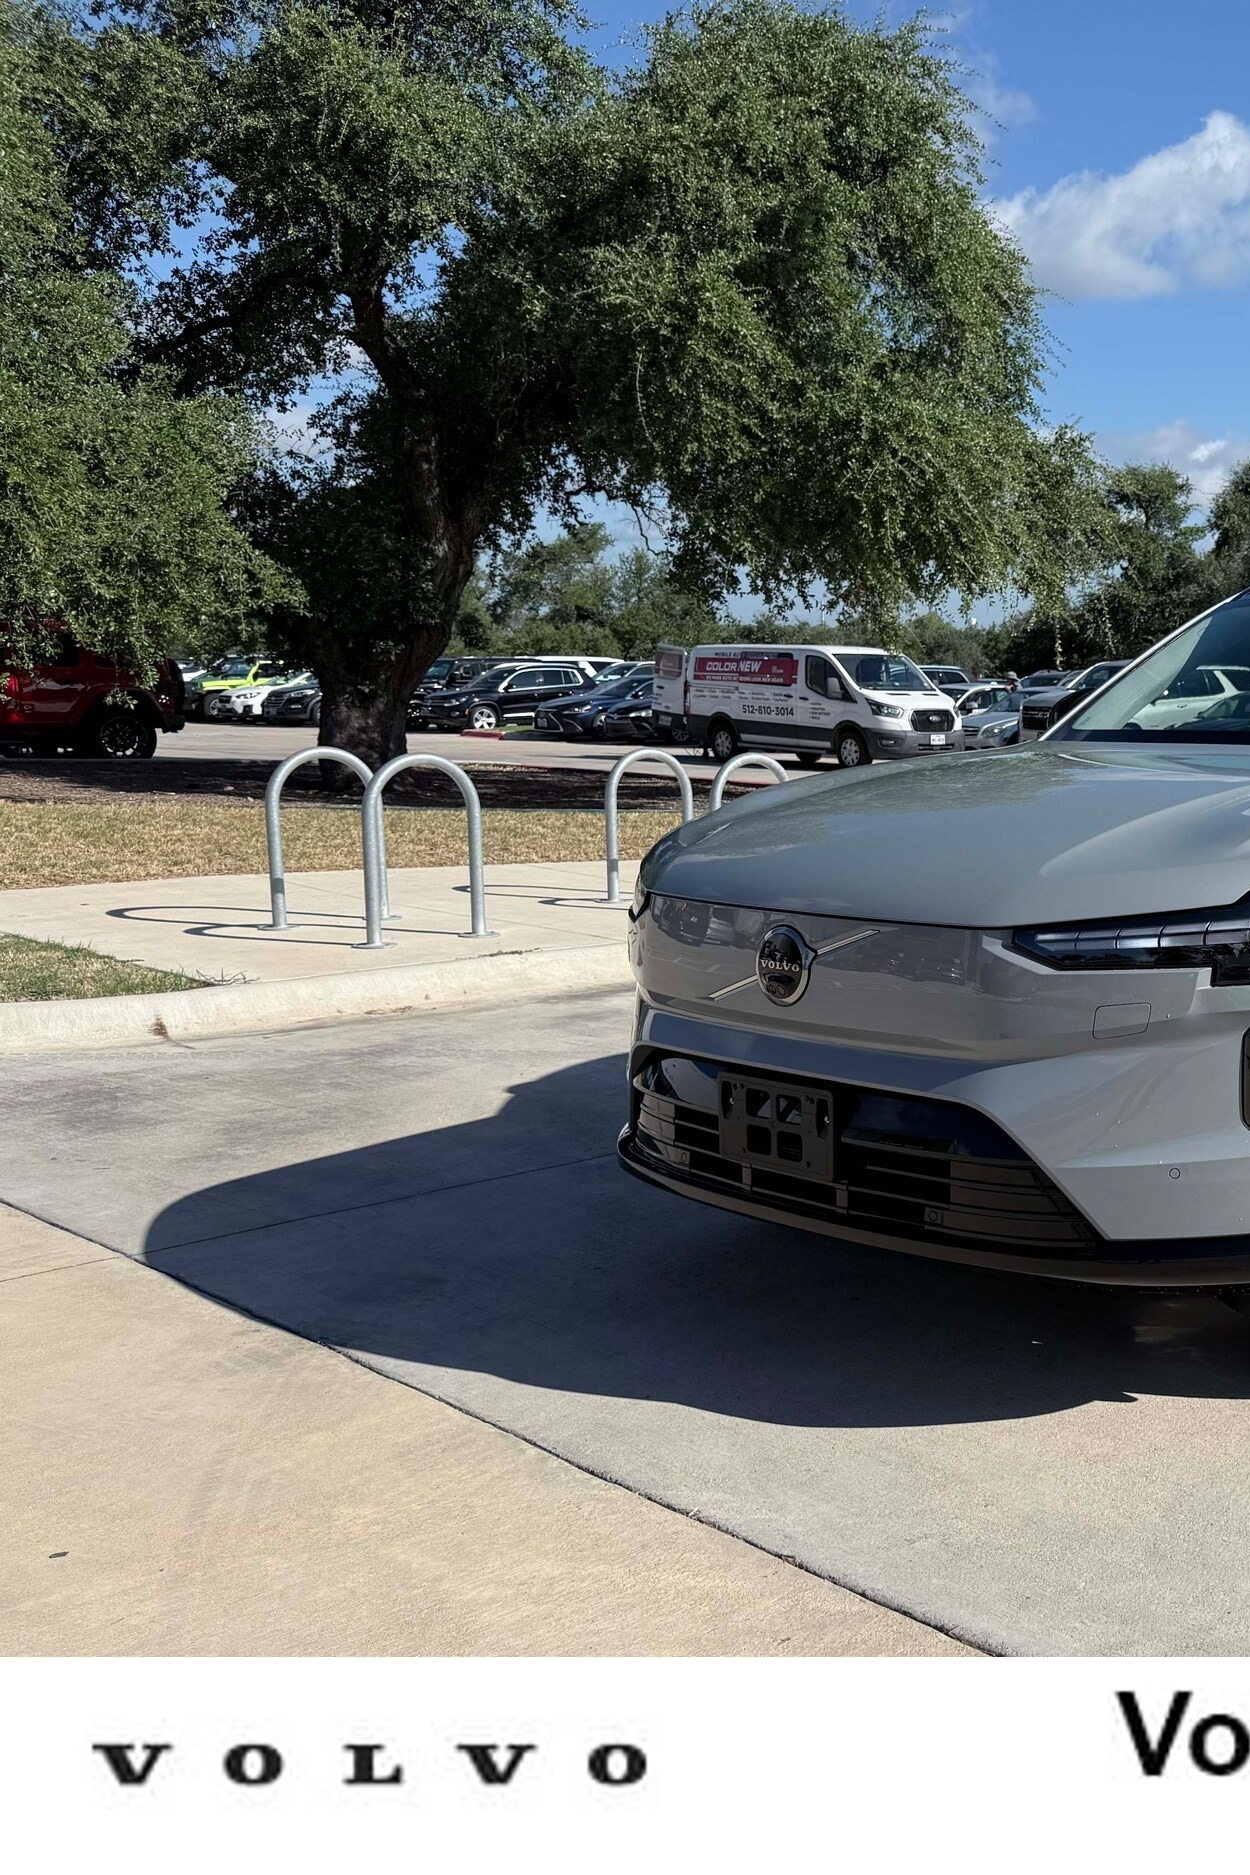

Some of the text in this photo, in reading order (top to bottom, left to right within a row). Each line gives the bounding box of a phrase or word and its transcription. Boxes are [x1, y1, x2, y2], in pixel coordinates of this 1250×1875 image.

[706, 661, 736, 672] COLOR
[737, 660, 762, 673] NEW
[742, 704, 794, 716] 512-810-3014
[760, 959, 800, 972] VOLVO
